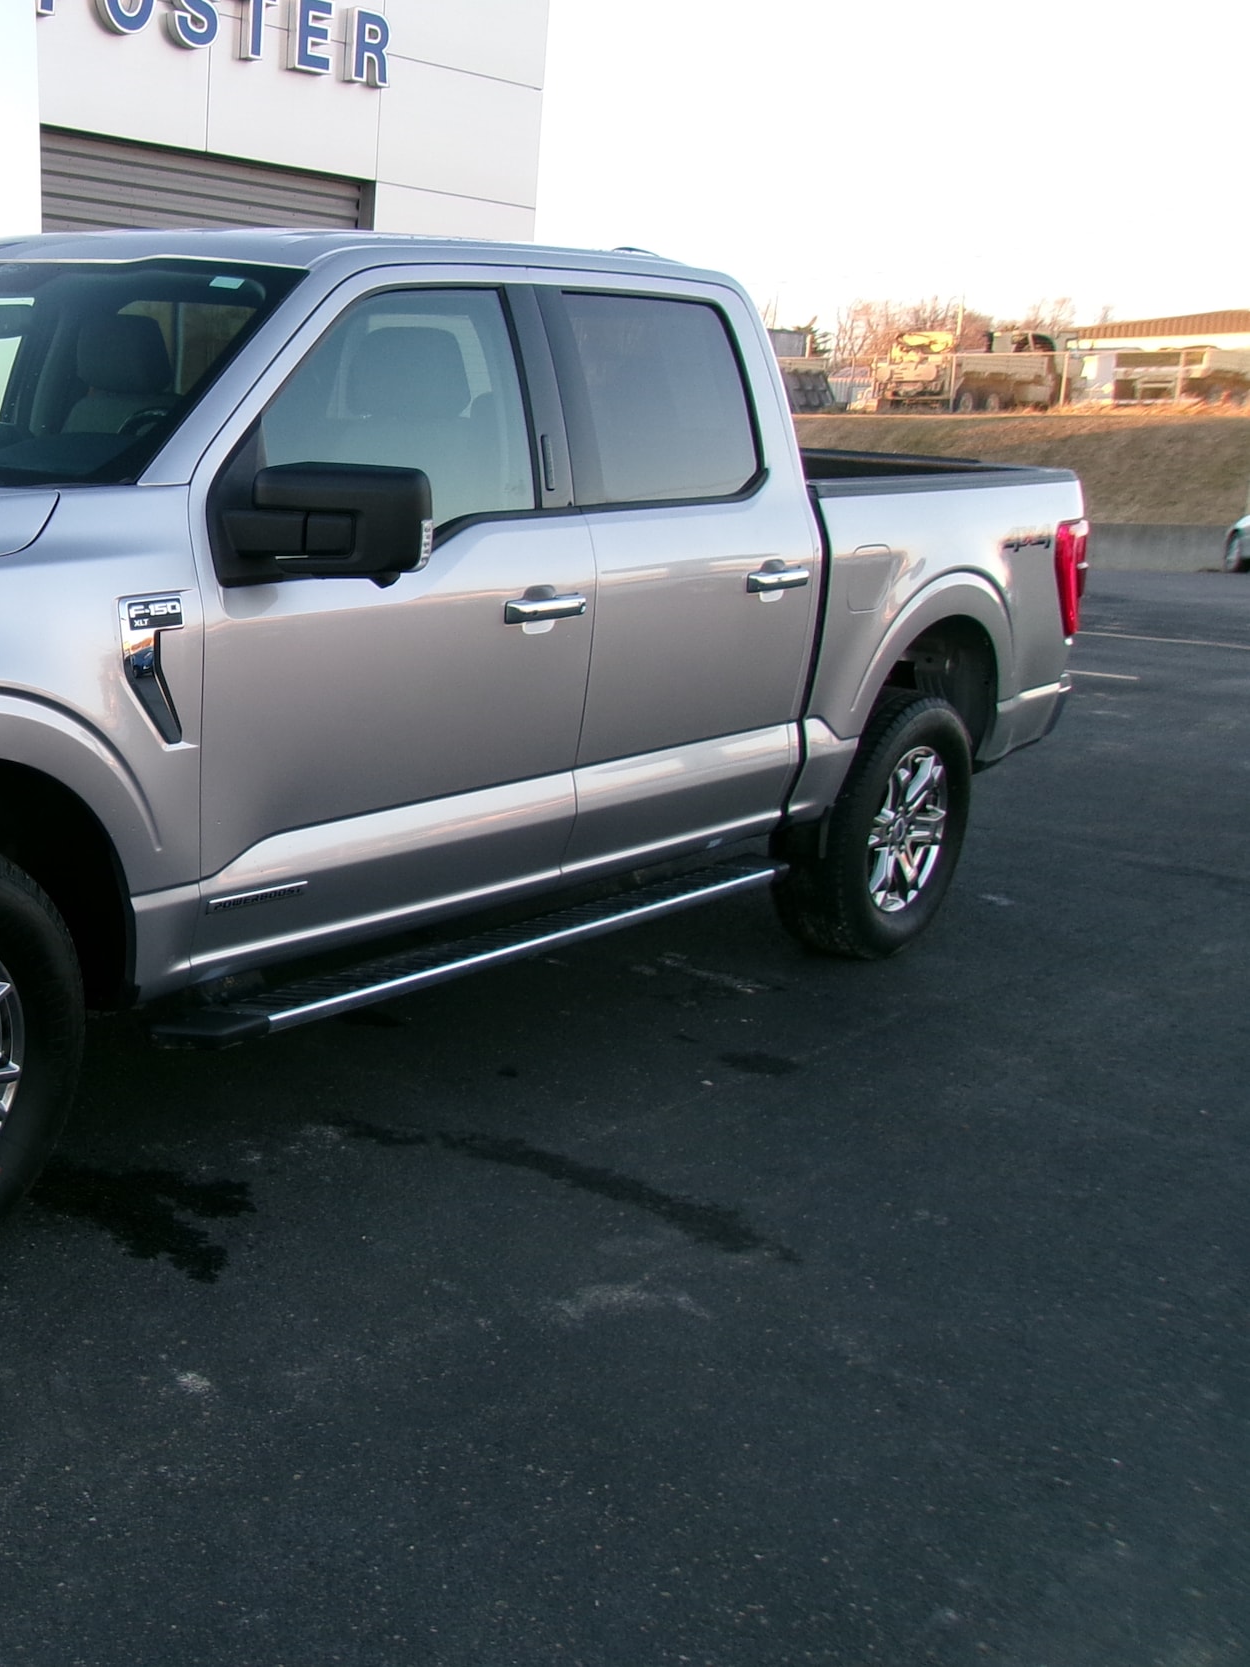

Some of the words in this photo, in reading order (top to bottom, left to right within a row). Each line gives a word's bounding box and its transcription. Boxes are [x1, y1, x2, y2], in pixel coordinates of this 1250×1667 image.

[37, 0, 391, 88] STER
[130, 601, 181, 618] F-150
[134, 619, 149, 627] XLT
